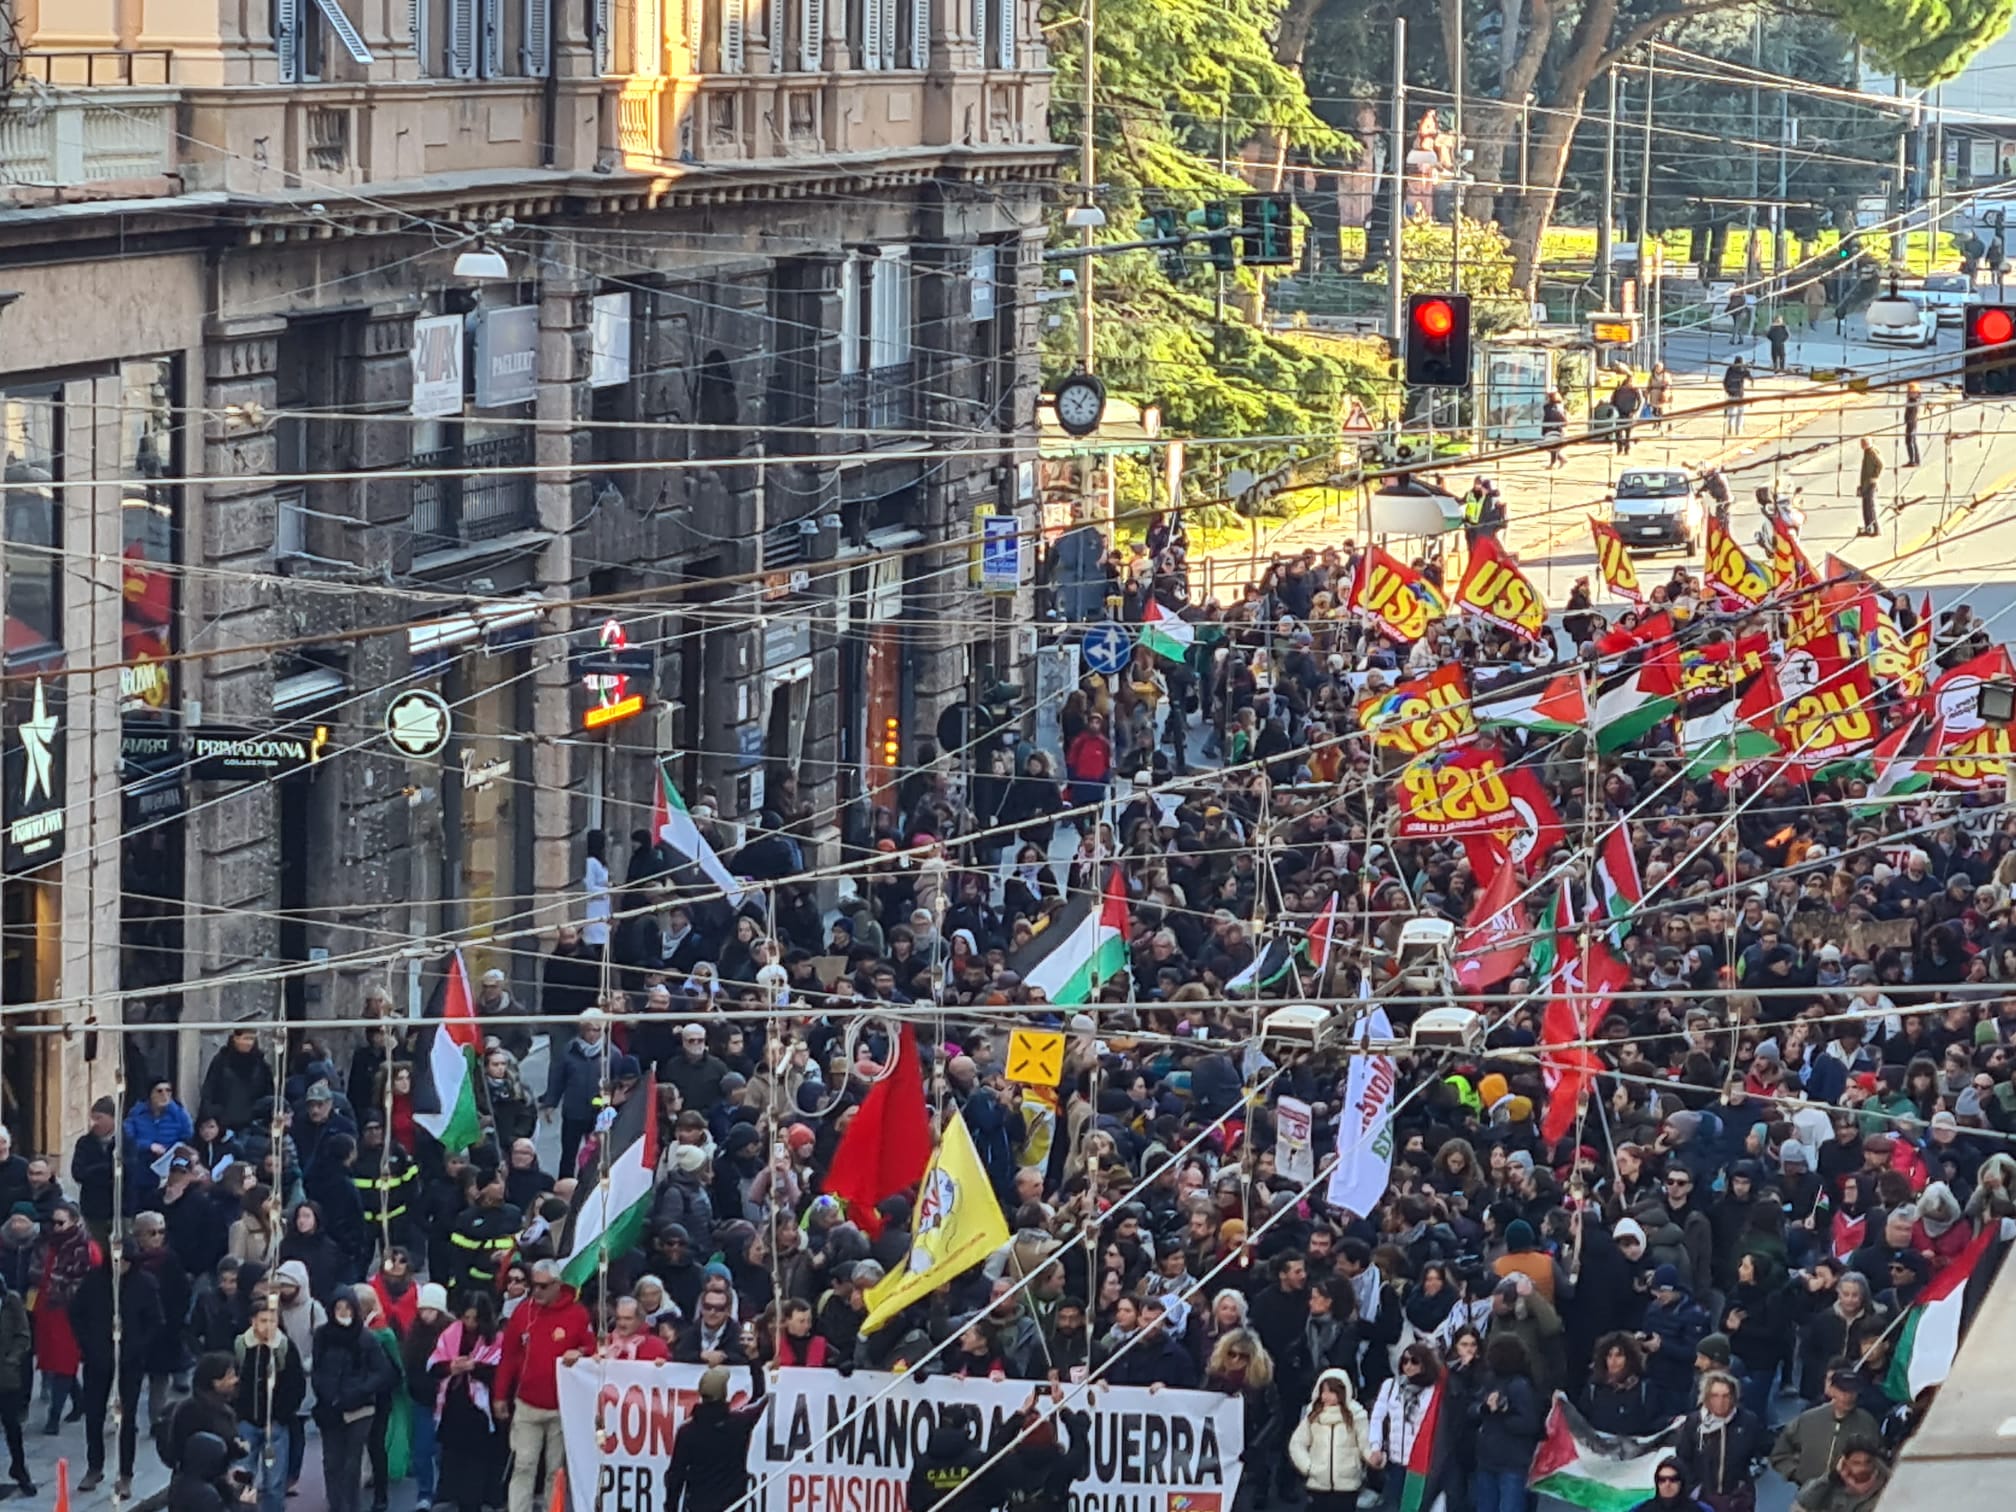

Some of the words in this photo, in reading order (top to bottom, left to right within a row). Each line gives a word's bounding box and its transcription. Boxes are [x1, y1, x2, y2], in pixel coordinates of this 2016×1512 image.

[197, 739, 306, 760] PRIMADONNA
[766, 1393, 813, 1463] LA
[600, 1464, 653, 1512] PER
